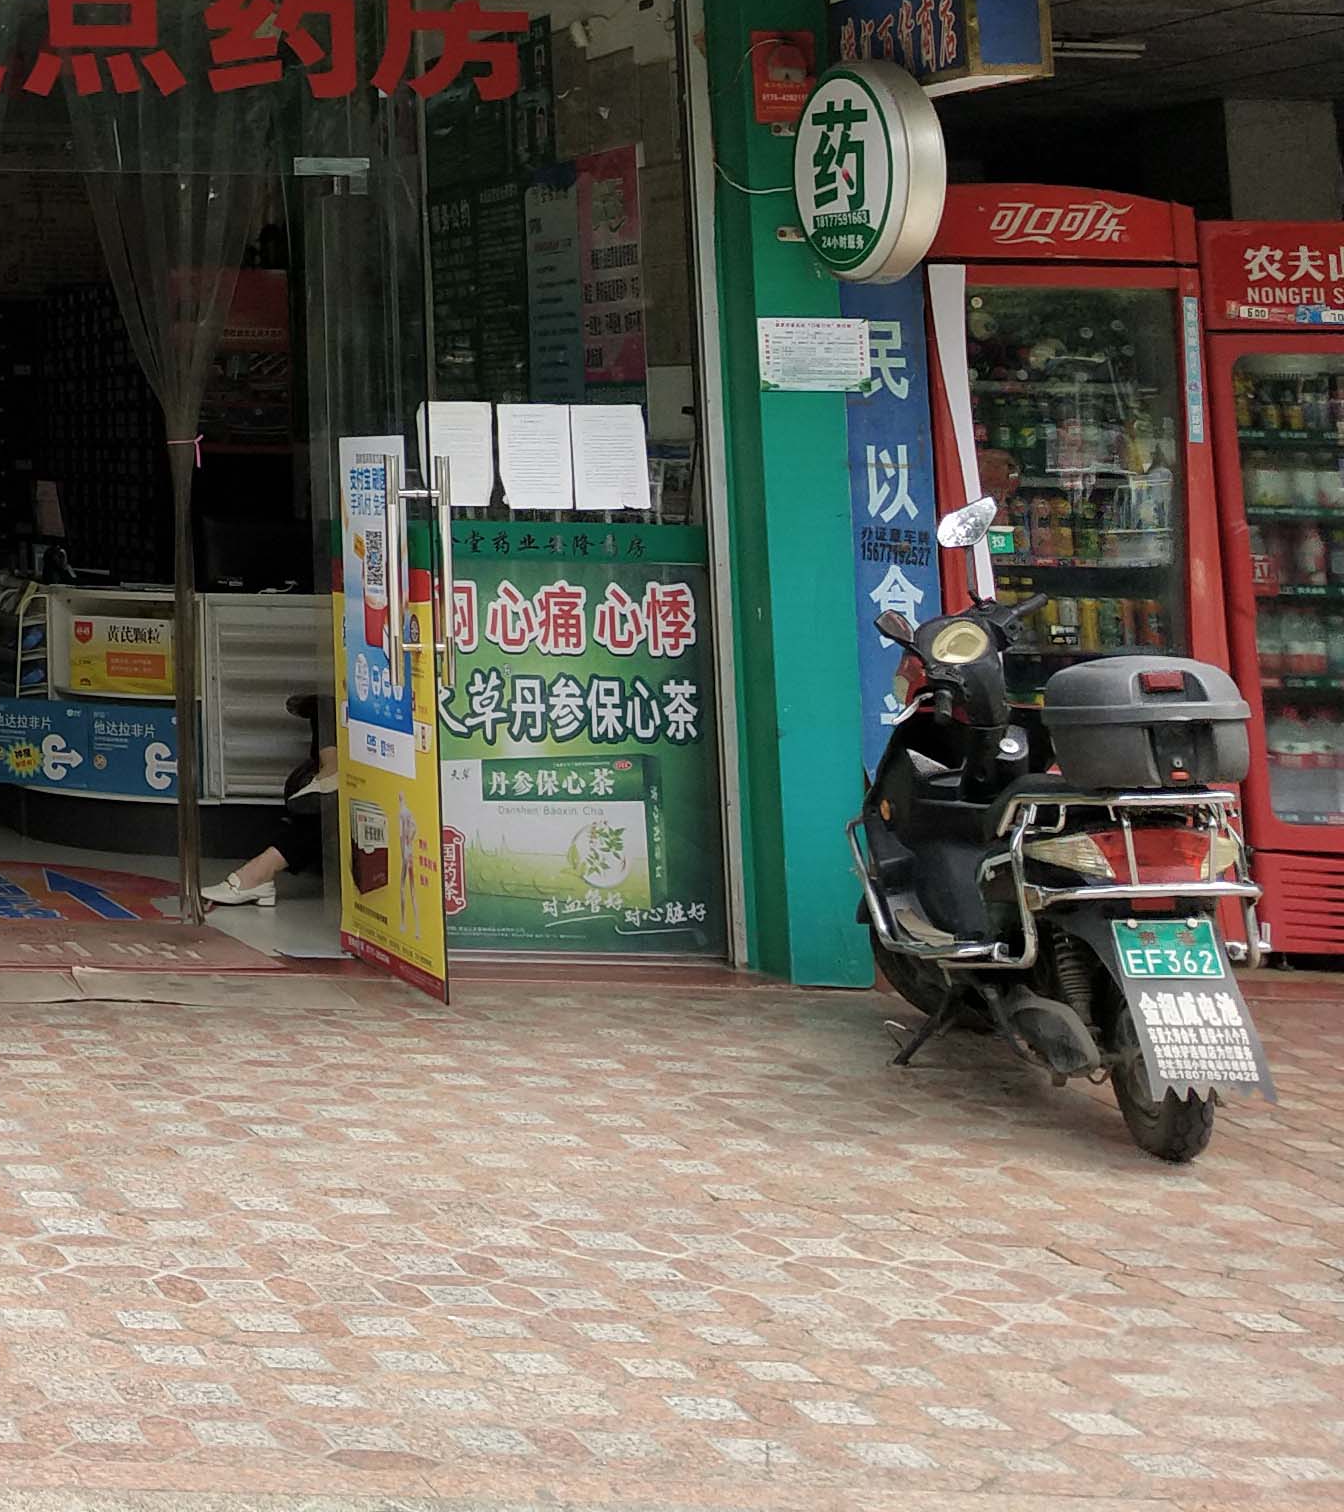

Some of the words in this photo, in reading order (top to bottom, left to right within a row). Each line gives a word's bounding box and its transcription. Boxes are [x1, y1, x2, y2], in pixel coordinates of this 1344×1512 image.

[812, 98, 868, 211] 药
[989, 200, 1136, 246] 可口可乐
[1247, 286, 1326, 305] NONGFU
[486, 580, 586, 655] 心痛
[595, 580, 697, 658] 心悸
[488, 767, 616, 797] 丹参保心茶
[624, 895, 706, 925] 对心脏好
[1125, 949, 1217, 974] EF362
